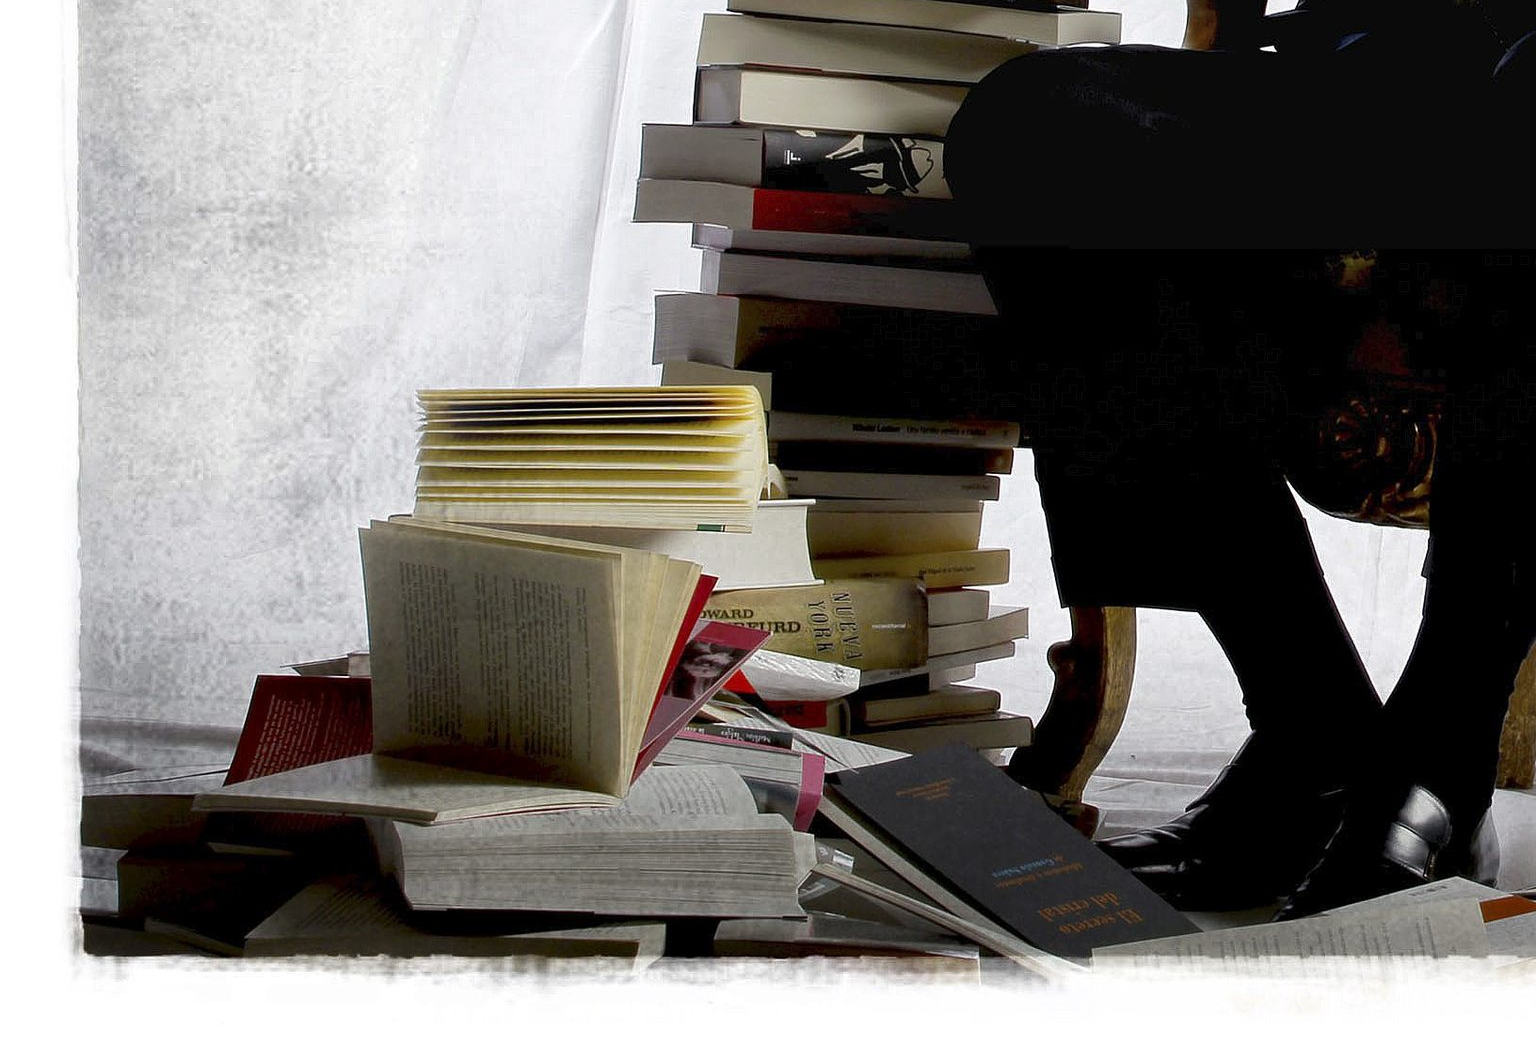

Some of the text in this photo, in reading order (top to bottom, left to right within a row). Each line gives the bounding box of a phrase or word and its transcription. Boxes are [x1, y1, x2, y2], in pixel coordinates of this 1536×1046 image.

[700, 609, 754, 619] DWARD
[808, 600, 835, 655] YORK
[832, 591, 863, 660] NUEVA
[1039, 891, 1120, 922] del cristal
[1059, 908, 1144, 934] El secreto
